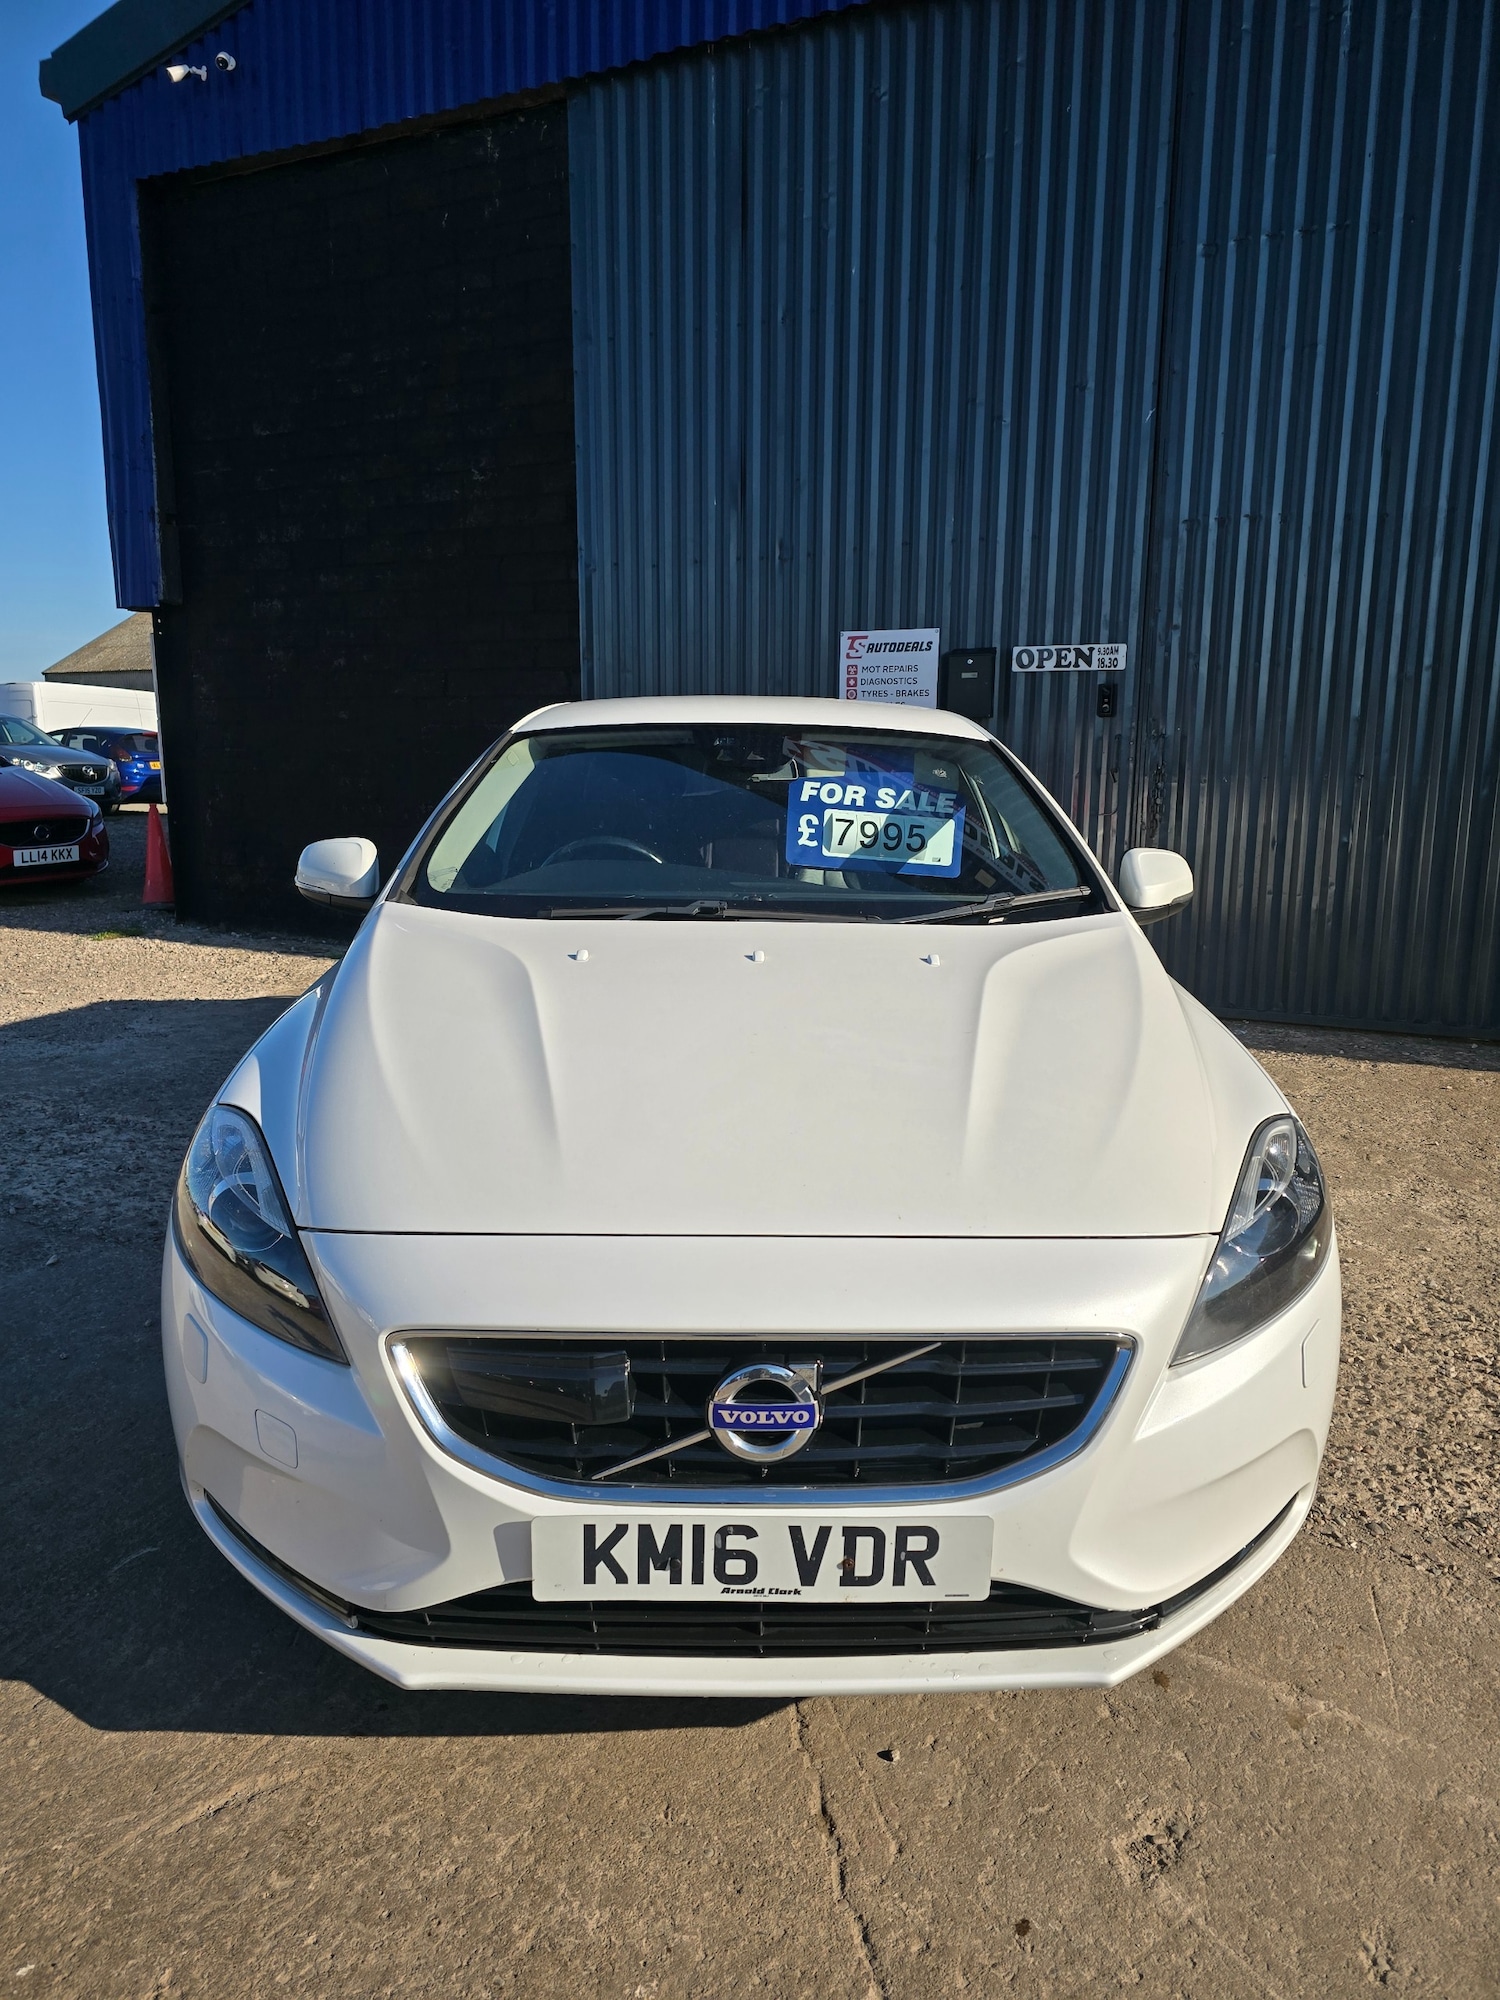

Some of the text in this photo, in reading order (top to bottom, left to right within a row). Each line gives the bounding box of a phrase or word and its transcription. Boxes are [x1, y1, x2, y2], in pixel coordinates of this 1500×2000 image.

[866, 641, 933, 653] AUTODEALS
[1097, 647, 1119, 656] 9.30AM
[1015, 647, 1094, 669] OPEN
[1097, 658, 1119, 668] 18.30
[883, 664, 919, 673] REPAIRS
[861, 678, 918, 686] DIAGNOSTICS
[861, 690, 888, 698] TYRES
[895, 689, 930, 697] BRAKES
[800, 781, 957, 813] FOR SALE
[21, 849, 73, 863] LL14 KKX
[718, 1410, 810, 1424] VOLVO
[583, 1524, 940, 1587] KM16 VDR
[720, 1587, 765, 1595] Arnold
